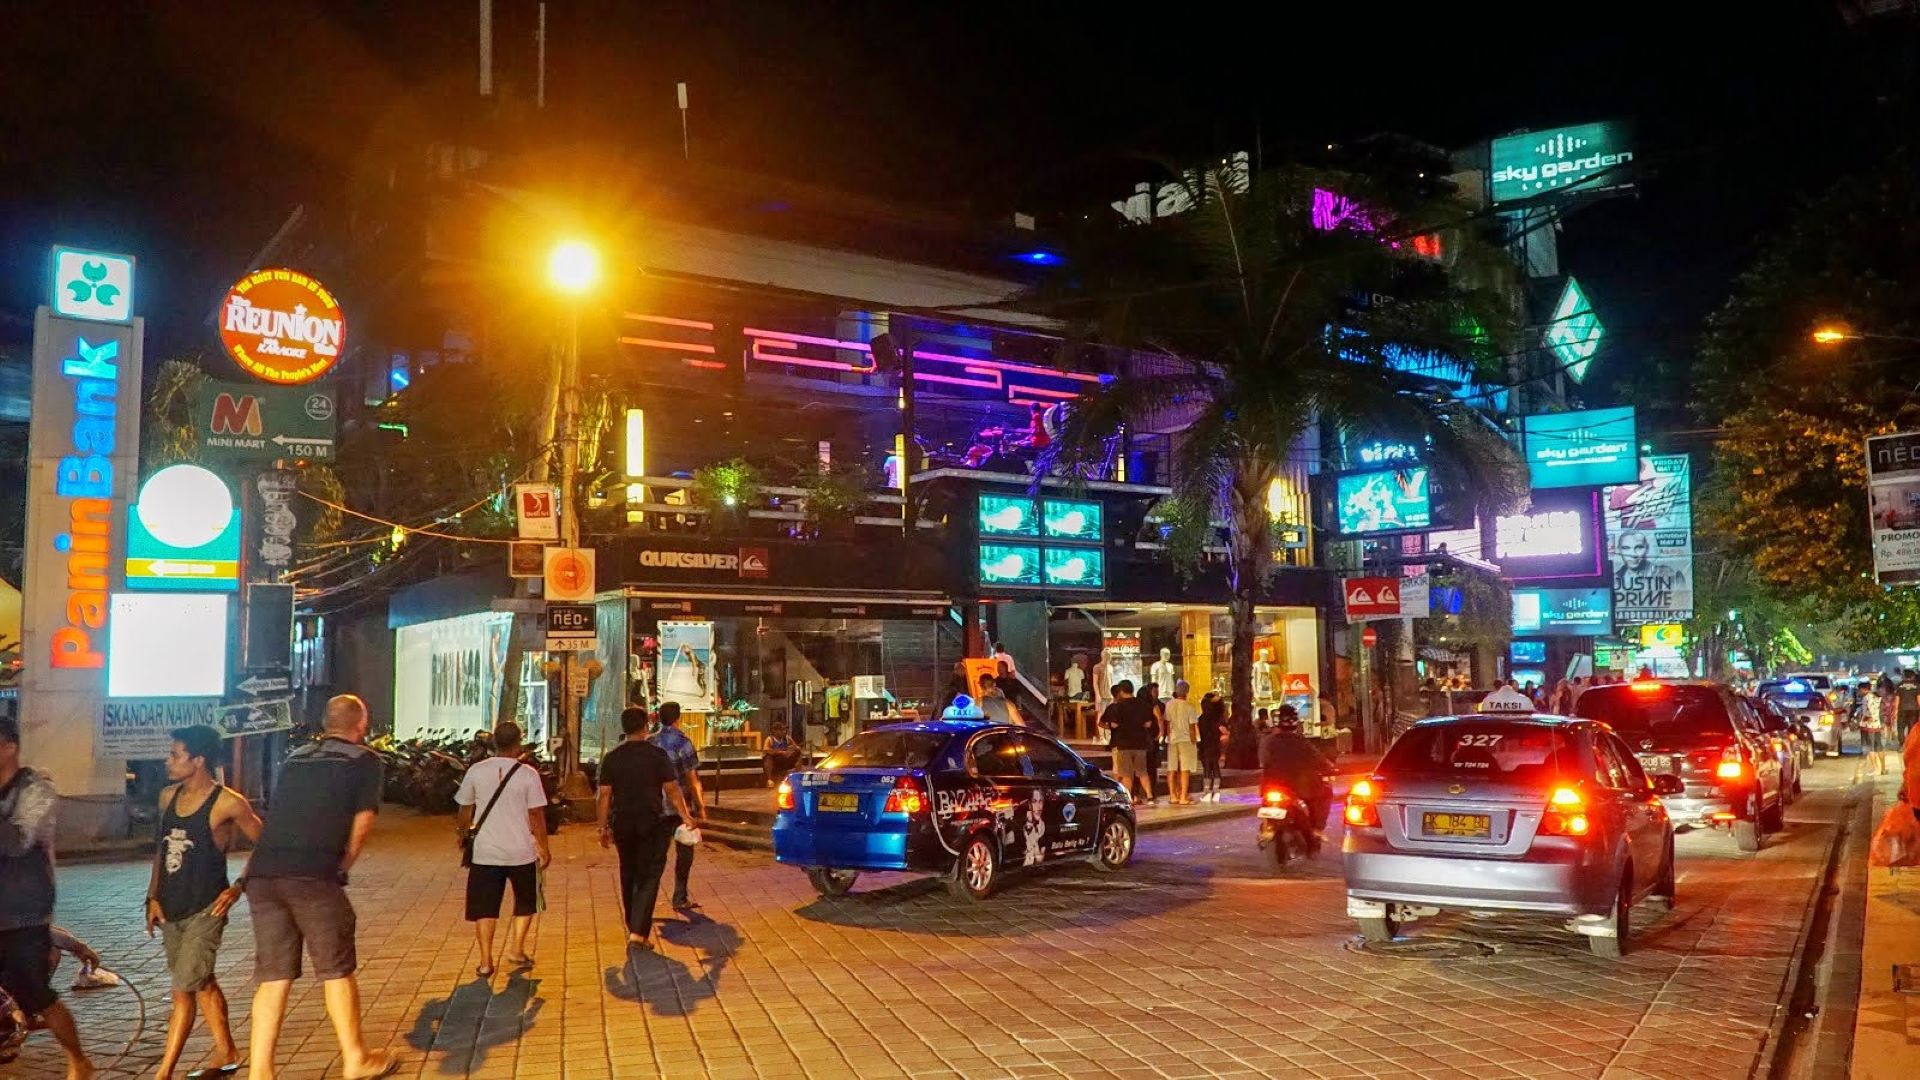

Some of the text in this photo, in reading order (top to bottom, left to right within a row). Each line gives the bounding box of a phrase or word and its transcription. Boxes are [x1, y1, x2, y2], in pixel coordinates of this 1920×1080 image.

[1492, 152, 1633, 182] sky garden
[225, 304, 342, 346] REUNION
[207, 438, 266, 449] MINI MART
[287, 445, 327, 457] 150 M
[1537, 447, 1566, 459] sky
[640, 551, 738, 569] QUIKSILVER
[1614, 577, 1671, 591] JUSTIN
[580, 640, 589, 648] M
[1489, 701, 1522, 709] TAKSI
[103, 703, 164, 727] ISKANDAR
[167, 703, 213, 727] NAWING
[1459, 734, 1503, 747] 327
